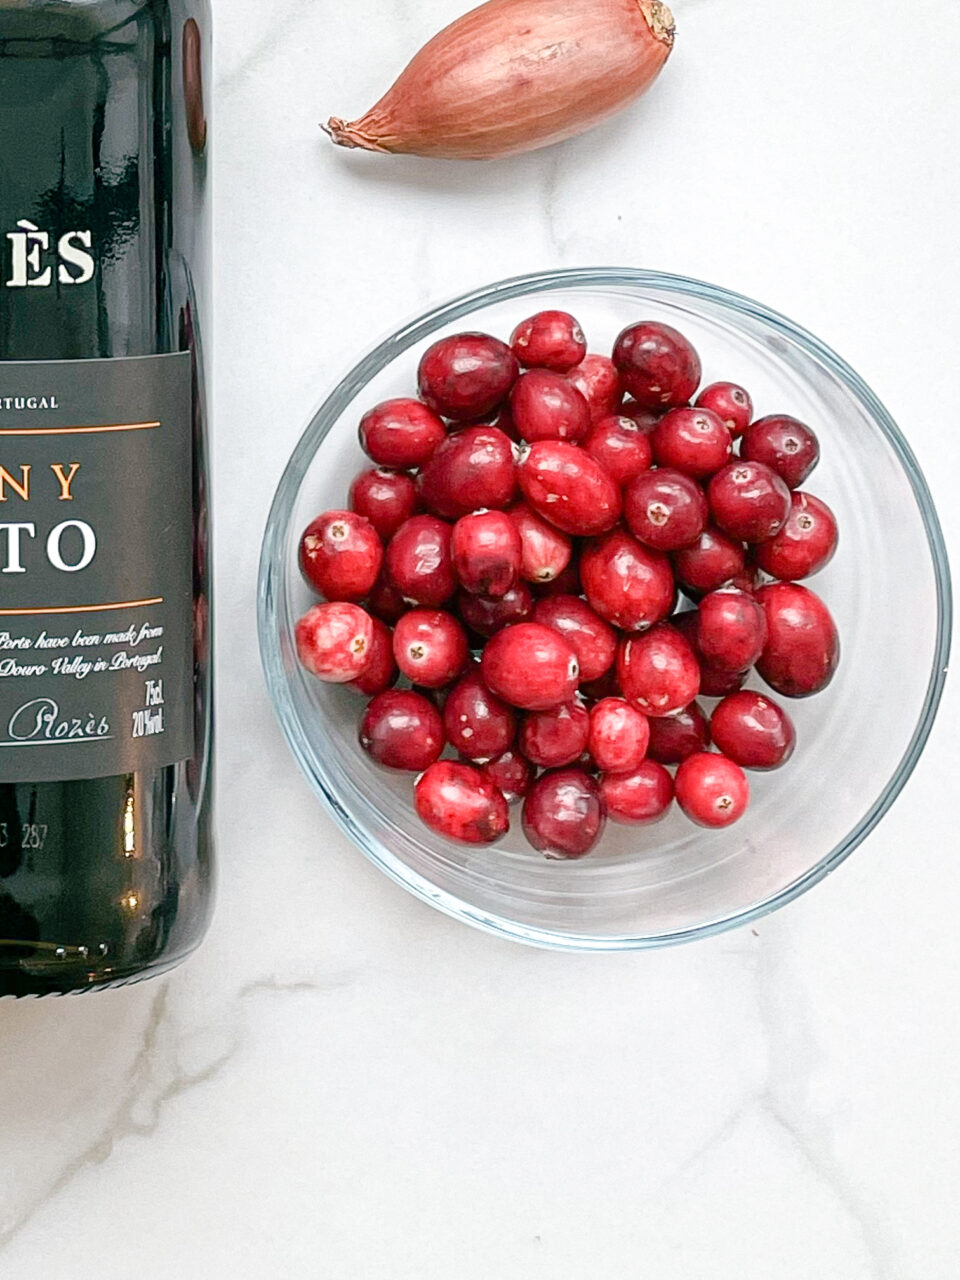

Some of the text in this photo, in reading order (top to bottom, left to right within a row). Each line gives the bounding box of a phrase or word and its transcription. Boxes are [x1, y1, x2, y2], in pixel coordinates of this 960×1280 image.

[34, 631, 70, 649] have
[72, 629, 101, 647] been
[103, 624, 137, 644] made
[130, 622, 164, 646] from
[51, 655, 91, 679] Valley
[93, 658, 109, 671] in
